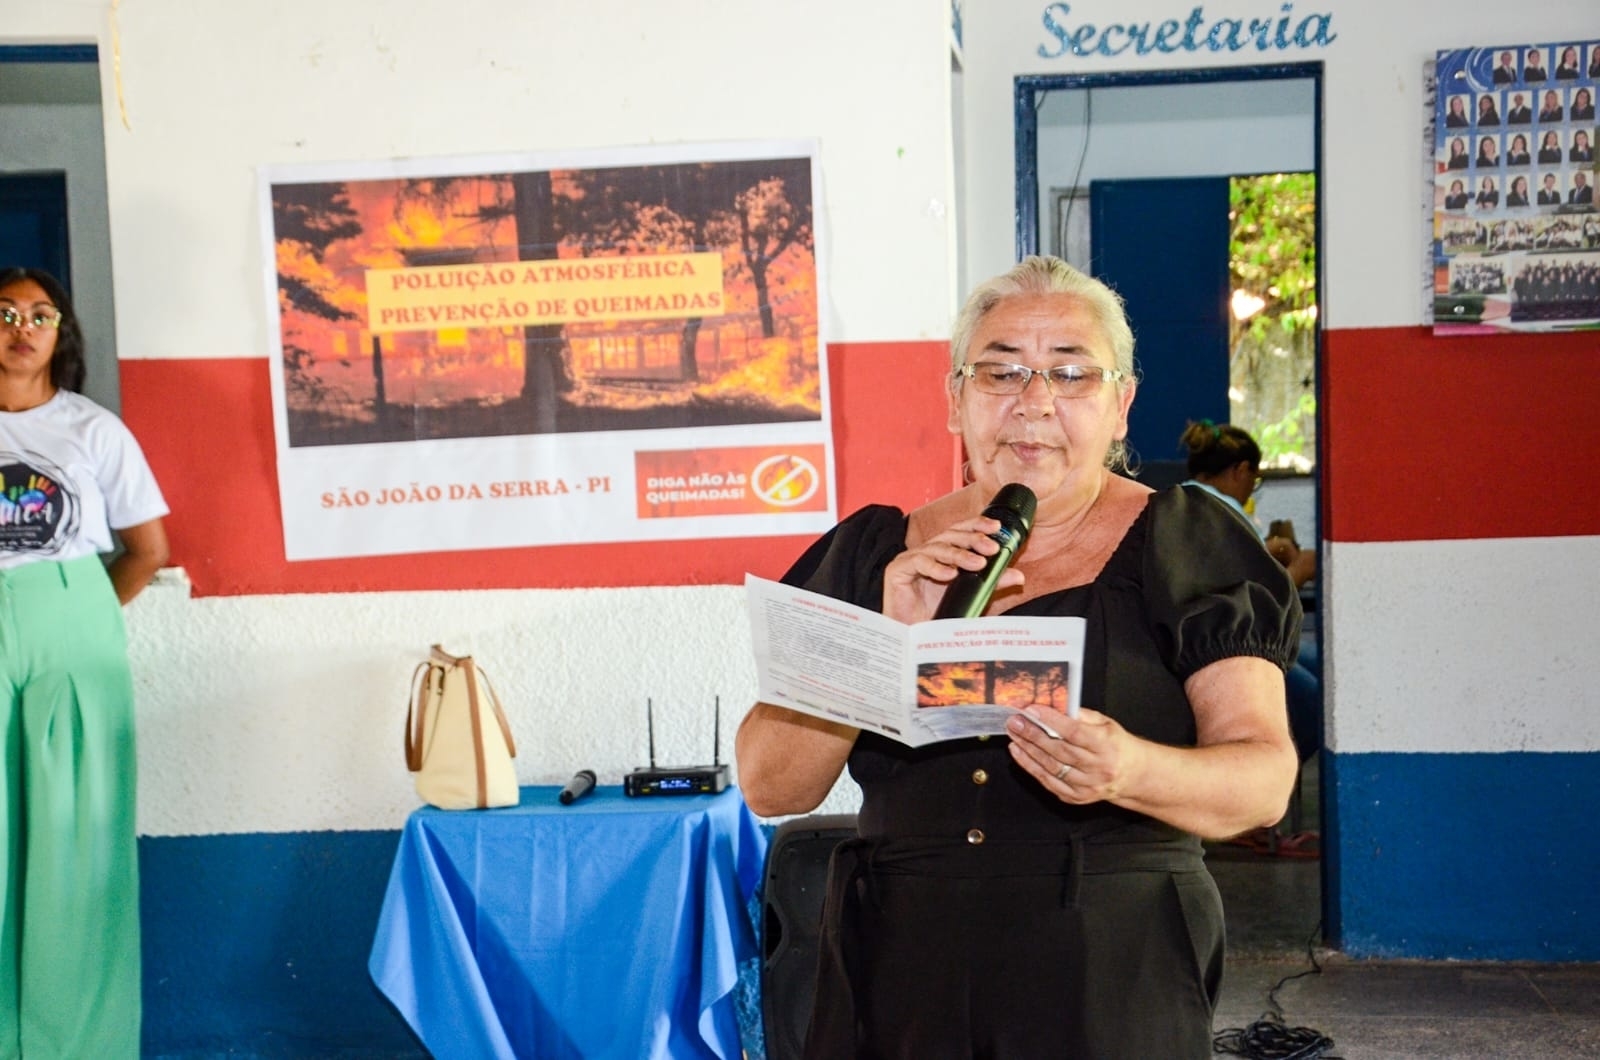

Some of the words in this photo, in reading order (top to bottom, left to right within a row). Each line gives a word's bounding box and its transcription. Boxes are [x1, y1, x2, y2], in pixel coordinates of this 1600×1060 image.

[1037, 2, 1338, 59] Secretaria
[391, 263, 515, 290] POLUIÇÃO
[522, 258, 696, 283] ATMOSFÉRICA
[380, 297, 529, 324] PREVENÇÃO
[536, 299, 567, 316] DE
[573, 292, 722, 317] QUEIMADAS
[320, 487, 370, 508] SÃO
[376, 482, 442, 505] JOÃO
[448, 484, 483, 500] DA
[489, 478, 569, 498] SERRA
[587, 476, 611, 493] PI
[646, 488, 746, 504] QUEIMADAS!
[647, 476, 686, 489] DIGA
[689, 471, 724, 487] NÃO
[726, 471, 747, 485] ÀS
